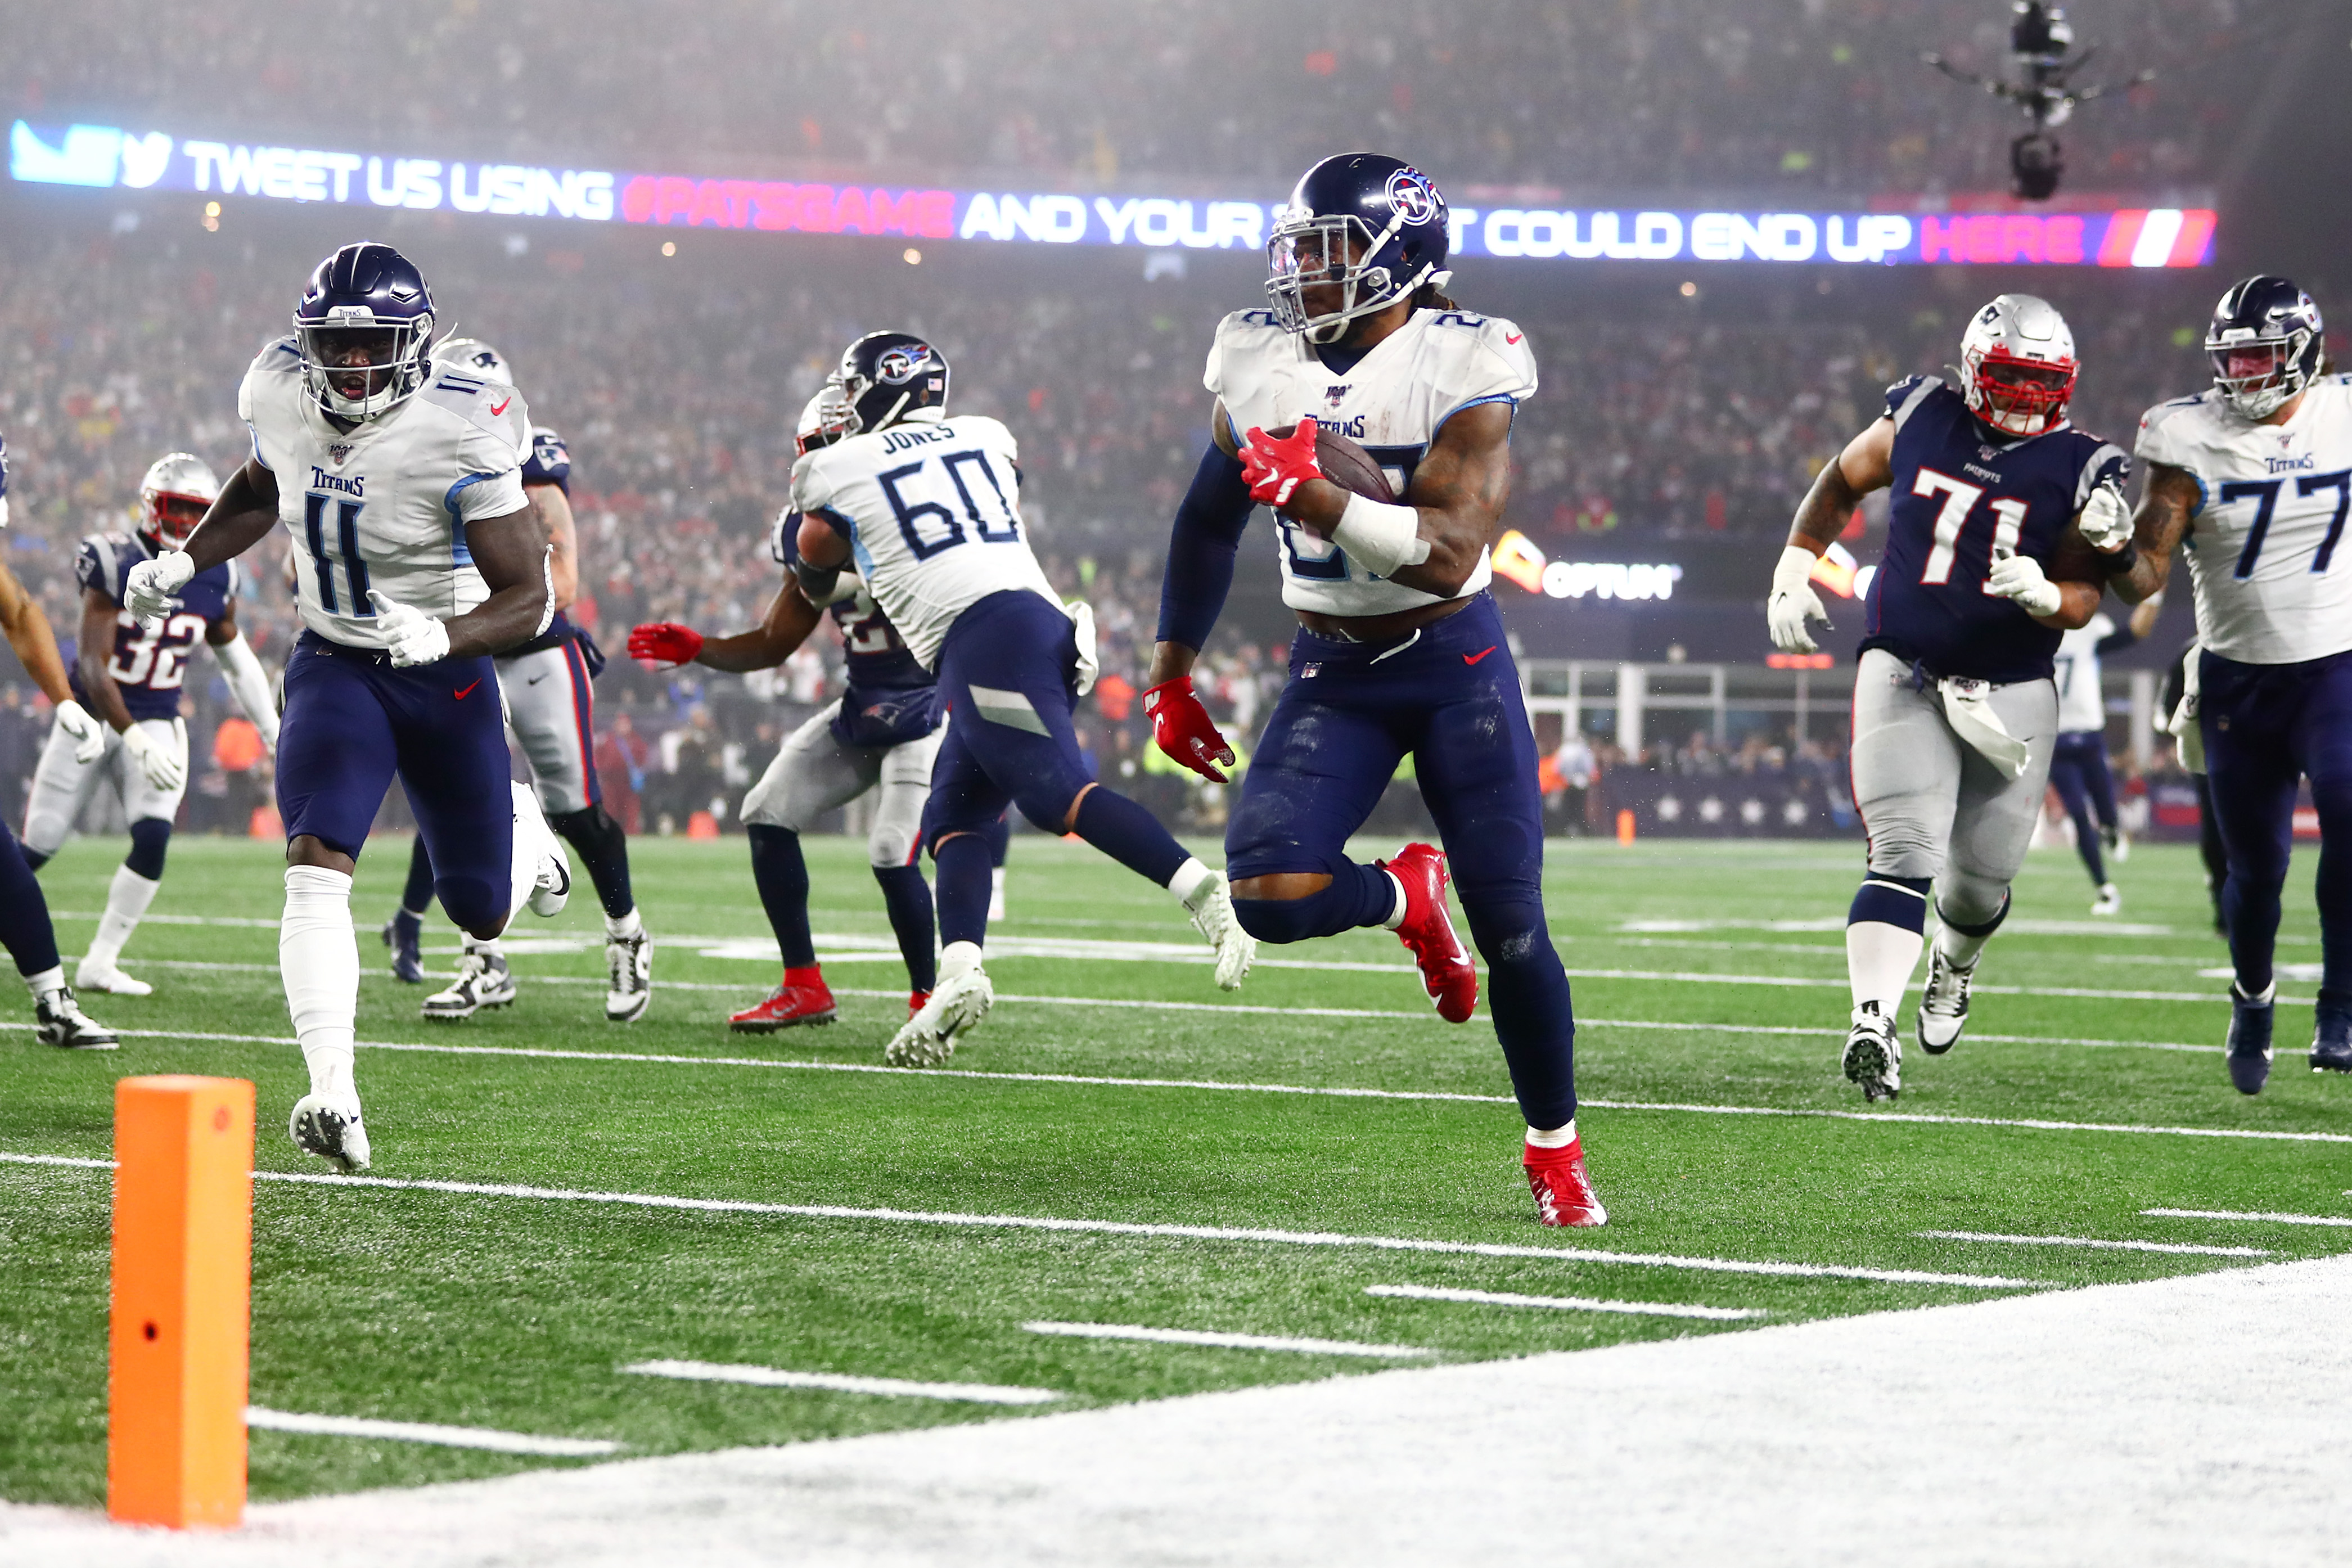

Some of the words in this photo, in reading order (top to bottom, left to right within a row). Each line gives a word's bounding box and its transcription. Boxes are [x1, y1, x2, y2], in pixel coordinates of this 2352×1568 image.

[182, 140, 362, 202] TWEET
[367, 156, 441, 209] US
[450, 163, 614, 220] USING
[623, 175, 955, 238] #PATSGAME
[959, 192, 1087, 243] AND
[1093, 197, 1264, 249] YOUR
[1484, 210, 1683, 259] COULD
[1691, 213, 1817, 262] END
[1827, 215, 1912, 262] UP
[1920, 216, 2085, 263] HERE
[312, 465, 364, 497] TITANS
[884, 425, 955, 455] JONES
[2264, 453, 2313, 474] TITANS
[876, 449, 1020, 562] 60
[1912, 466, 2030, 598] 71
[2219, 469, 2352, 579] 77
[305, 491, 376, 618] 11
[1542, 561, 1674, 600] OPTUM
[109, 611, 209, 690] 32
